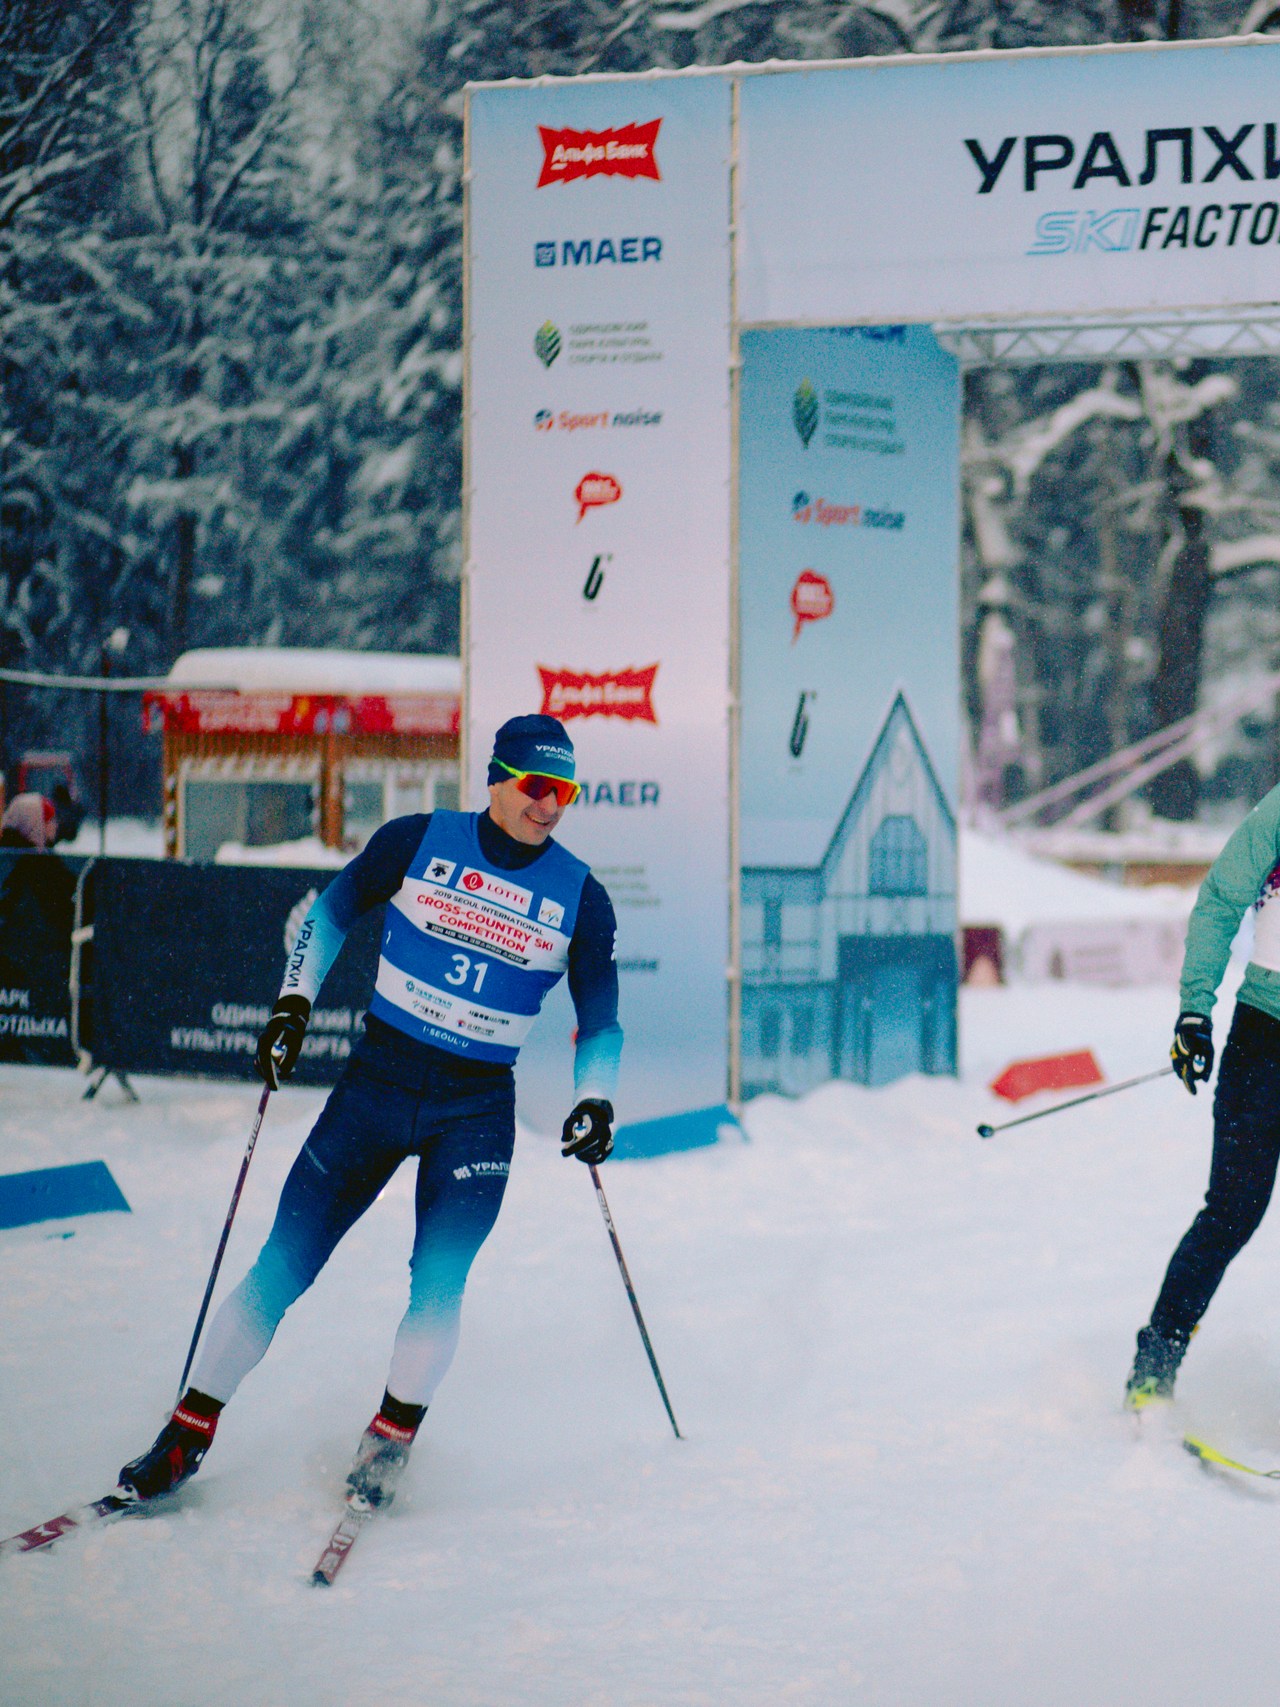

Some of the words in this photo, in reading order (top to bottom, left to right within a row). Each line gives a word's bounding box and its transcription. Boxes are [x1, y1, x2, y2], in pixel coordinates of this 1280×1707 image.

[561, 236, 663, 267] MAER
[433, 888, 452, 901] 2019
[453, 894, 479, 910] SEOUL
[481, 904, 544, 936] INTERNATIONAL
[486, 882, 529, 908] LOTTE
[416, 894, 532, 944] CROSS-COUNTRY
[534, 937, 555, 952] SKI
[438, 913, 526, 954] COMPETITION
[444, 952, 489, 994] 31
